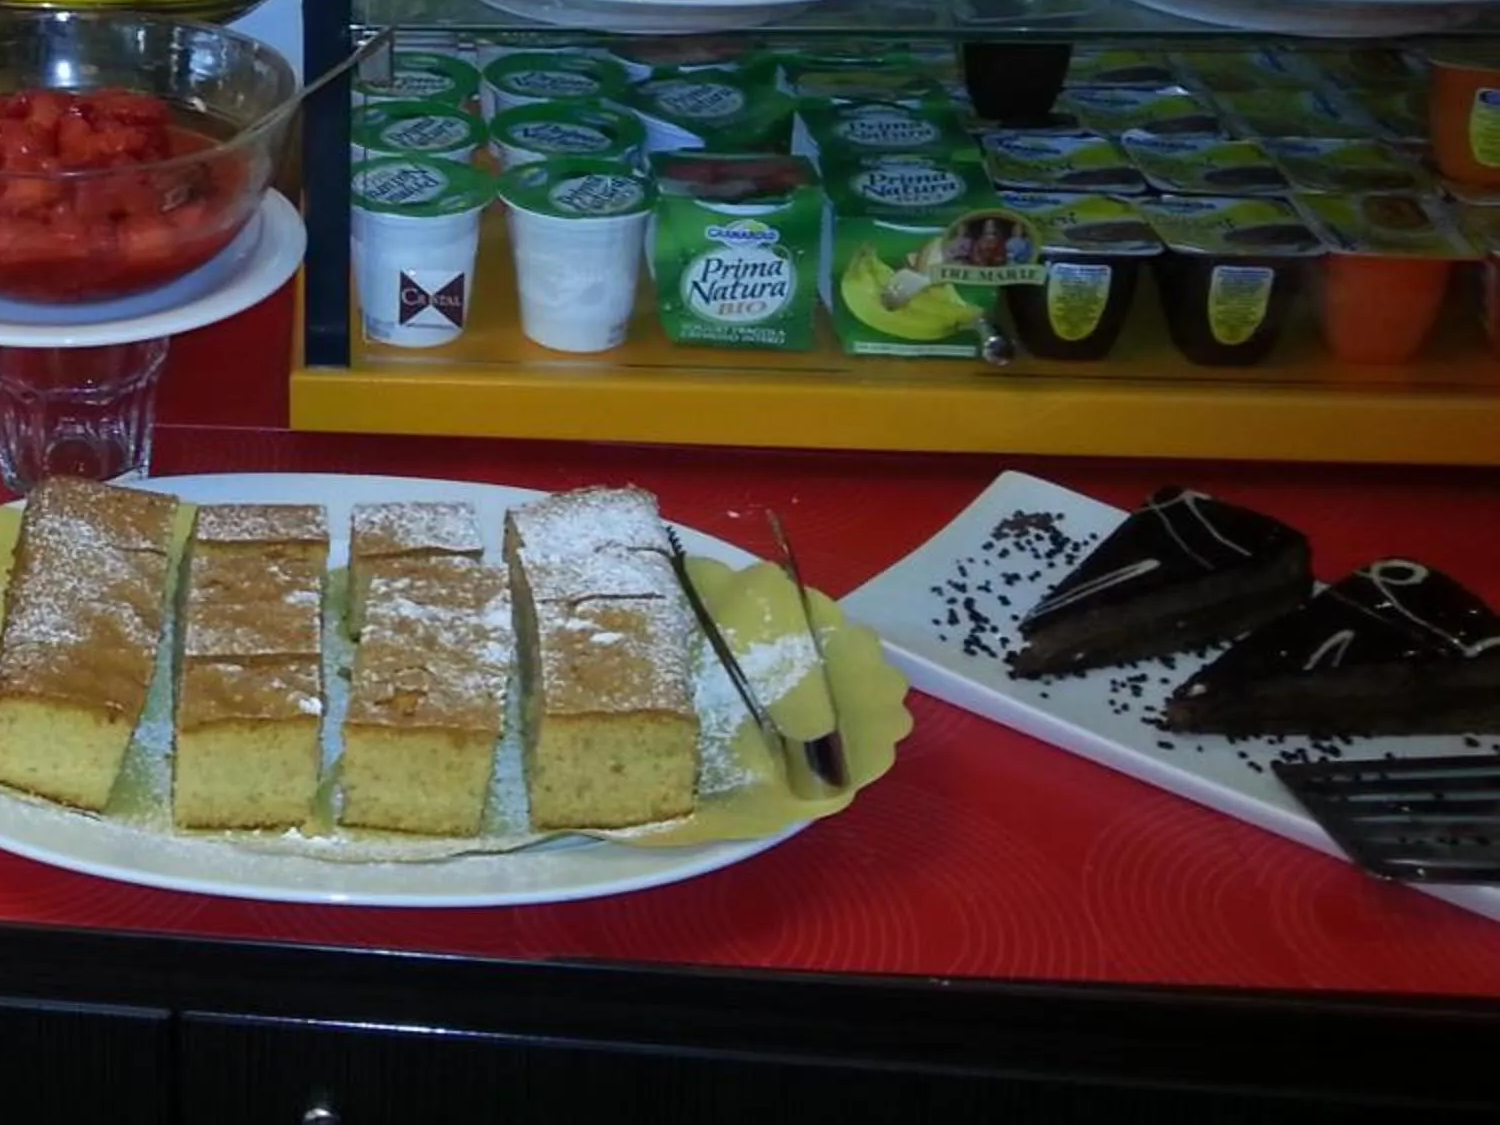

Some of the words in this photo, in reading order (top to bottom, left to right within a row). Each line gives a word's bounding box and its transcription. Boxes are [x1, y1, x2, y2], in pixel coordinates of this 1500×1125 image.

[701, 257, 784, 284] Prima
[690, 279, 788, 306] Natura
[717, 300, 768, 316] BIO
